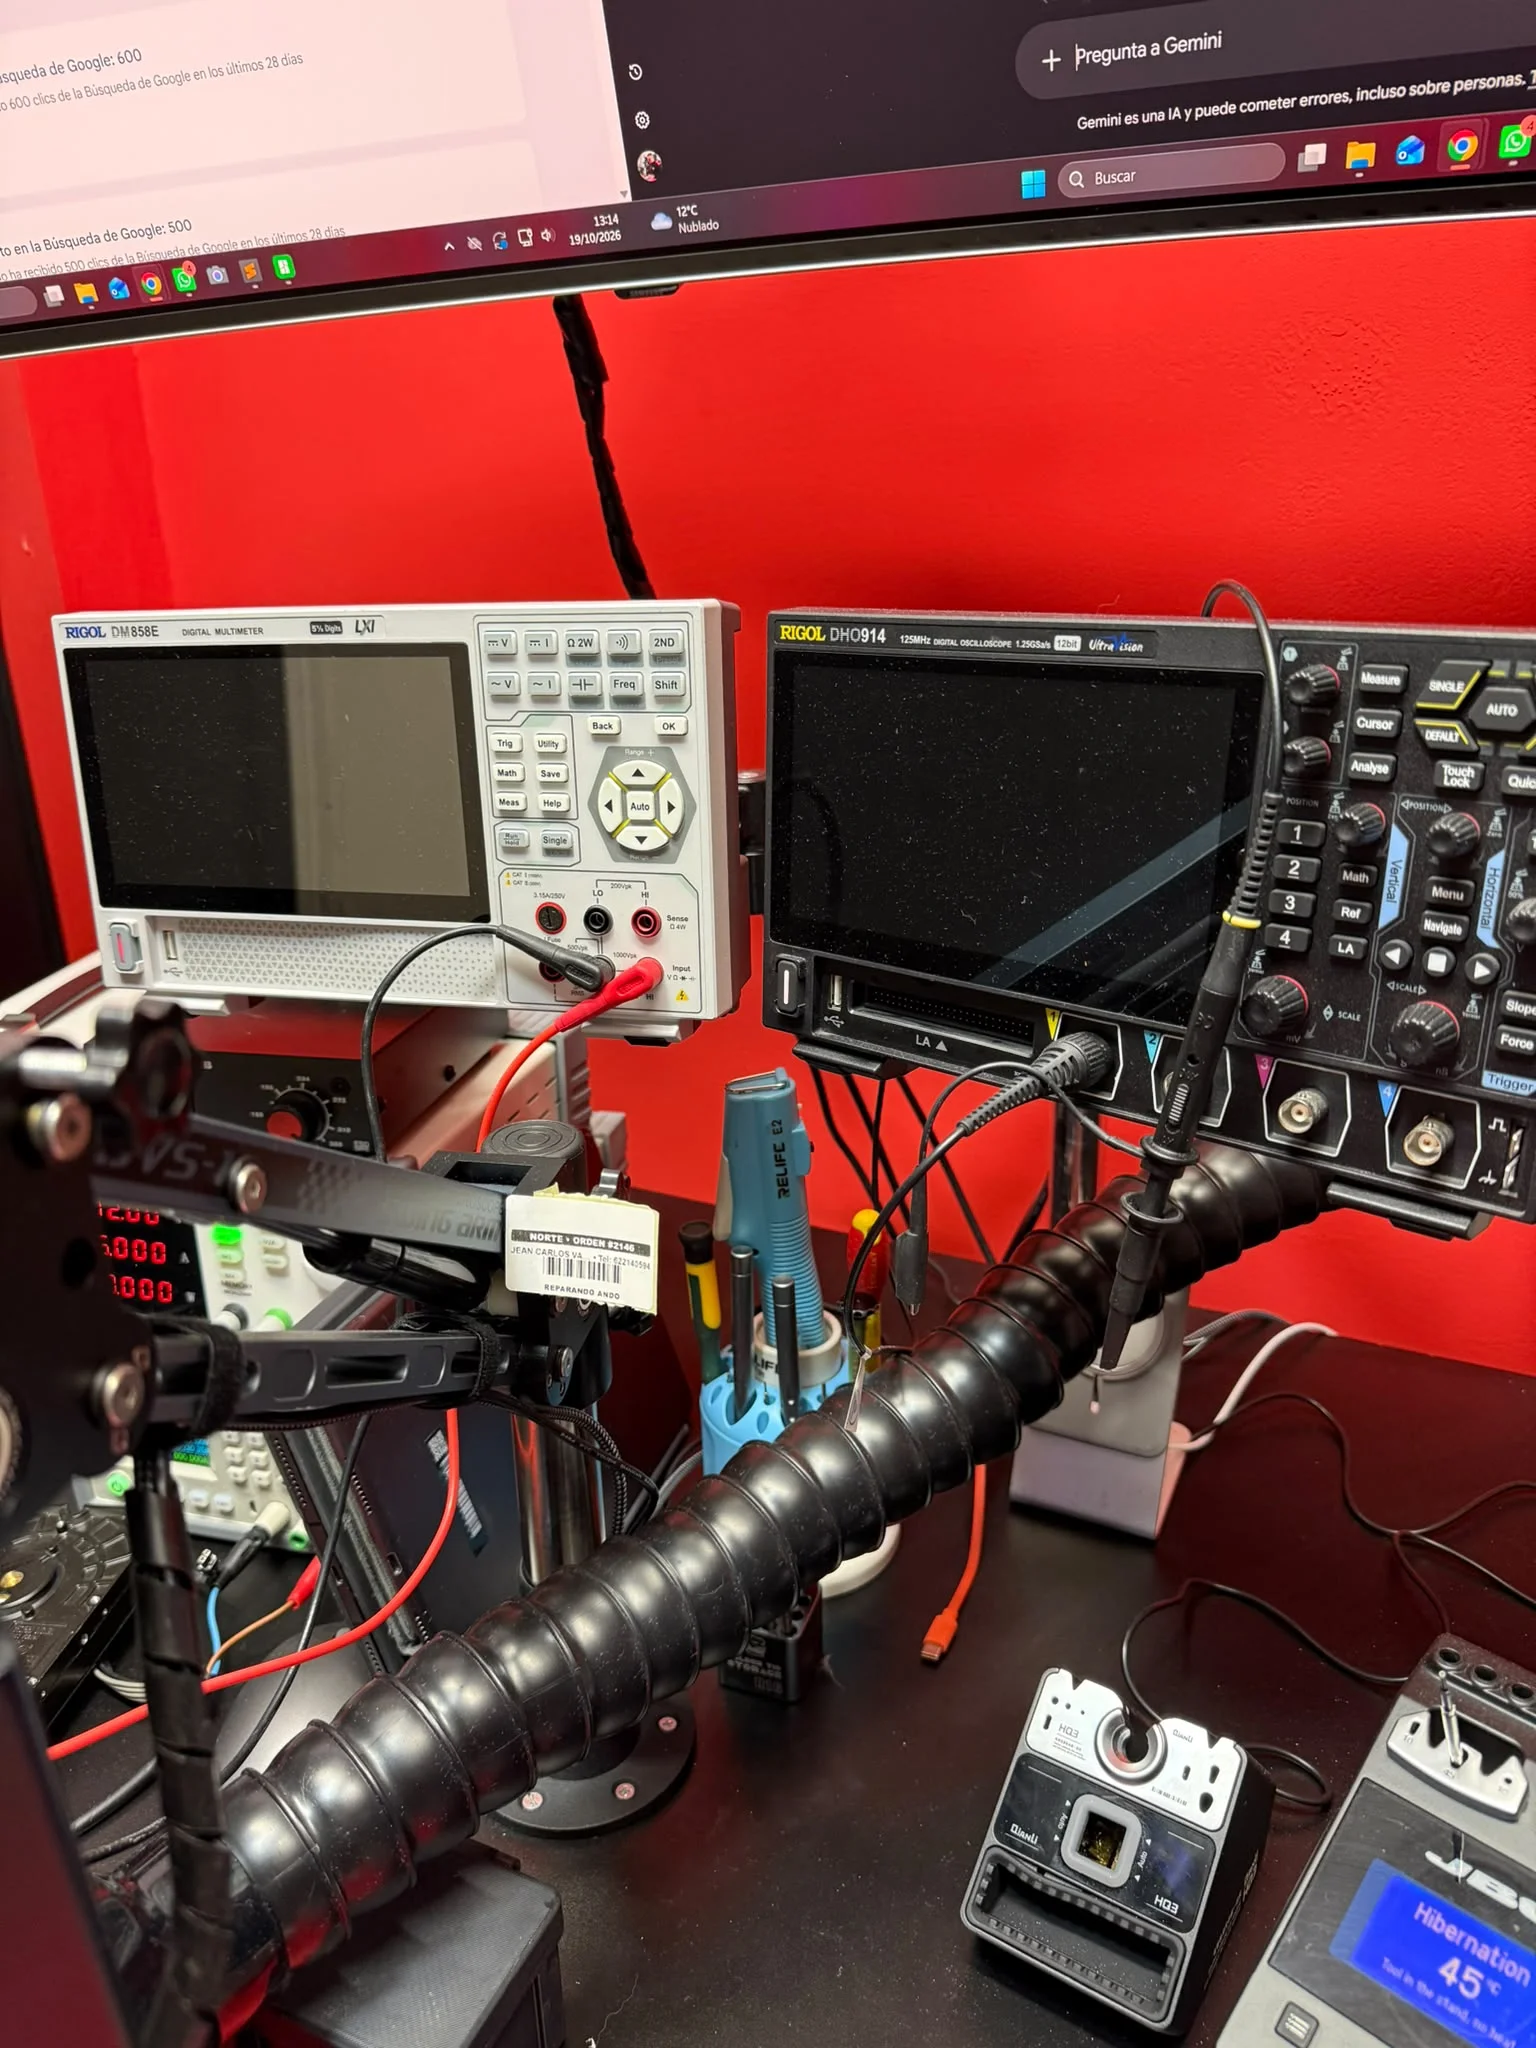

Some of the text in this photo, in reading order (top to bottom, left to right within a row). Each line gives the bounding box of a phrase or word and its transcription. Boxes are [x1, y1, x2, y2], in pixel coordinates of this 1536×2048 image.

[1077, 30, 1222, 67] Pregunta a Gemini
[49, 61, 65, 76] de
[67, 53, 115, 72] Google:
[117, 48, 142, 65] 600
[9, 95, 31, 109] 600
[32, 92, 56, 106] clics
[58, 90, 72, 102] de
[72, 87, 83, 100] la
[84, 79, 136, 98] Búsqueda
[138, 77, 152, 89] de
[153, 70, 191, 87] Google
[193, 70, 207, 81] en
[208, 66, 224, 78] los
[226, 61, 264, 75] últimos
[265, 56, 279, 69] 28
[280, 53, 304, 67] días
[1077, 72, 1526, 130] Gemini es una IA y puede cometer errores, incluso sobre personas.
[1095, 168, 1136, 185] Buscar
[676, 205, 698, 218] 12°C
[593, 213, 620, 227] 13:14
[678, 219, 720, 234] Nublado
[14, 218, 192, 255] en la Búsqueda de Google: 500
[569, 231, 622, 246] 19/10/2026
[8, 269, 23, 280] ha
[24, 262, 63, 277] recibido
[64, 259, 85, 272] 500
[87, 256, 110, 269] clics
[111, 253, 124, 266] de
[126, 252, 135, 264] la
[136, 245, 186, 262] Búsqueda
[188, 243, 200, 254] de
[202, 240, 238, 252] Google
[240, 239, 253, 248] en
[254, 236, 270, 246] los
[272, 232, 308, 245] últimos
[309, 229, 322, 239] 28
[324, 226, 346, 237] días
[65, 625, 159, 639] RIGOL DM858E
[181, 627, 264, 636] DIGITAL MULTIMETER
[355, 619, 375, 635] LXI
[780, 625, 886, 644] RIGOL DHO914
[501, 638, 508, 647] V
[577, 638, 593, 648] 2W
[654, 638, 675, 648] 2ND
[900, 635, 931, 645] 125MHz
[933, 638, 958, 646] DIGITAL
[960, 639, 1012, 649] OSCILLOSCOPE
[1057, 639, 1078, 649] 12bit
[504, 680, 512, 689] V
[613, 680, 636, 691] Freq
[654, 680, 678, 690] Shift
[1361, 672, 1401, 686] Measure
[1428, 680, 1465, 693] SINGLE
[1486, 703, 1519, 717] AUTO
[592, 721, 613, 731] Back
[662, 722, 676, 731] OK
[1356, 716, 1394, 730] Cursor
[1425, 729, 1460, 742] DEFAULT
[497, 739, 513, 748] Trig
[537, 739, 560, 750] Utility
[497, 769, 517, 777] Math
[540, 770, 561, 778] Save
[1351, 760, 1389, 775] Analyse
[1442, 764, 1475, 779] Touch
[1443, 776, 1471, 789] Lock
[498, 798, 520, 807] Meas
[543, 799, 562, 809] Help
[630, 802, 650, 811] Auto
[1409, 801, 1445, 813] POSITION
[1293, 825, 1302, 841] 1
[542, 836, 568, 847] Single
[1288, 860, 1300, 876] 2
[1342, 870, 1370, 884] Math
[1386, 859, 1404, 904] Vertical
[1431, 886, 1464, 901] Menu
[1480, 867, 1501, 930] Horizontal
[1284, 895, 1296, 911] 3
[666, 915, 689, 923] Sense
[1341, 906, 1362, 919] Ref
[1423, 919, 1463, 937] Navigate
[1279, 929, 1291, 945] 4
[1337, 942, 1354, 955] LA
[1395, 984, 1418, 994] SCALE
[1337, 1011, 1361, 1022] SCALE
[916, 1034, 931, 1048] LA
[1149, 1033, 1158, 1046] 2
[1500, 1033, 1535, 1050] Force
[1260, 1059, 1269, 1070] 3
[1487, 1074, 1534, 1093] Trigger
[1382, 1086, 1393, 1097] 4
[771, 1119, 791, 1199] RELIFE E2
[529, 1232, 563, 1243] NORTE
[573, 1236, 605, 1248] ORDEN
[511, 1246, 534, 1255] JEAN
[535, 1248, 570, 1258] CARLOS
[599, 1255, 612, 1264] Tel:
[544, 1284, 620, 1300] REPARANDO ANDO
[1058, 1723, 1080, 1739] HQ3
[1057, 1813, 1068, 1831] Auto
[1136, 1850, 1148, 1869] Auto
[1154, 1894, 1179, 1915] HQ3
[1413, 1901, 1532, 1988] Hibernation
[1438, 1957, 1485, 2000] 45
[1416, 1979, 1435, 1999] the
